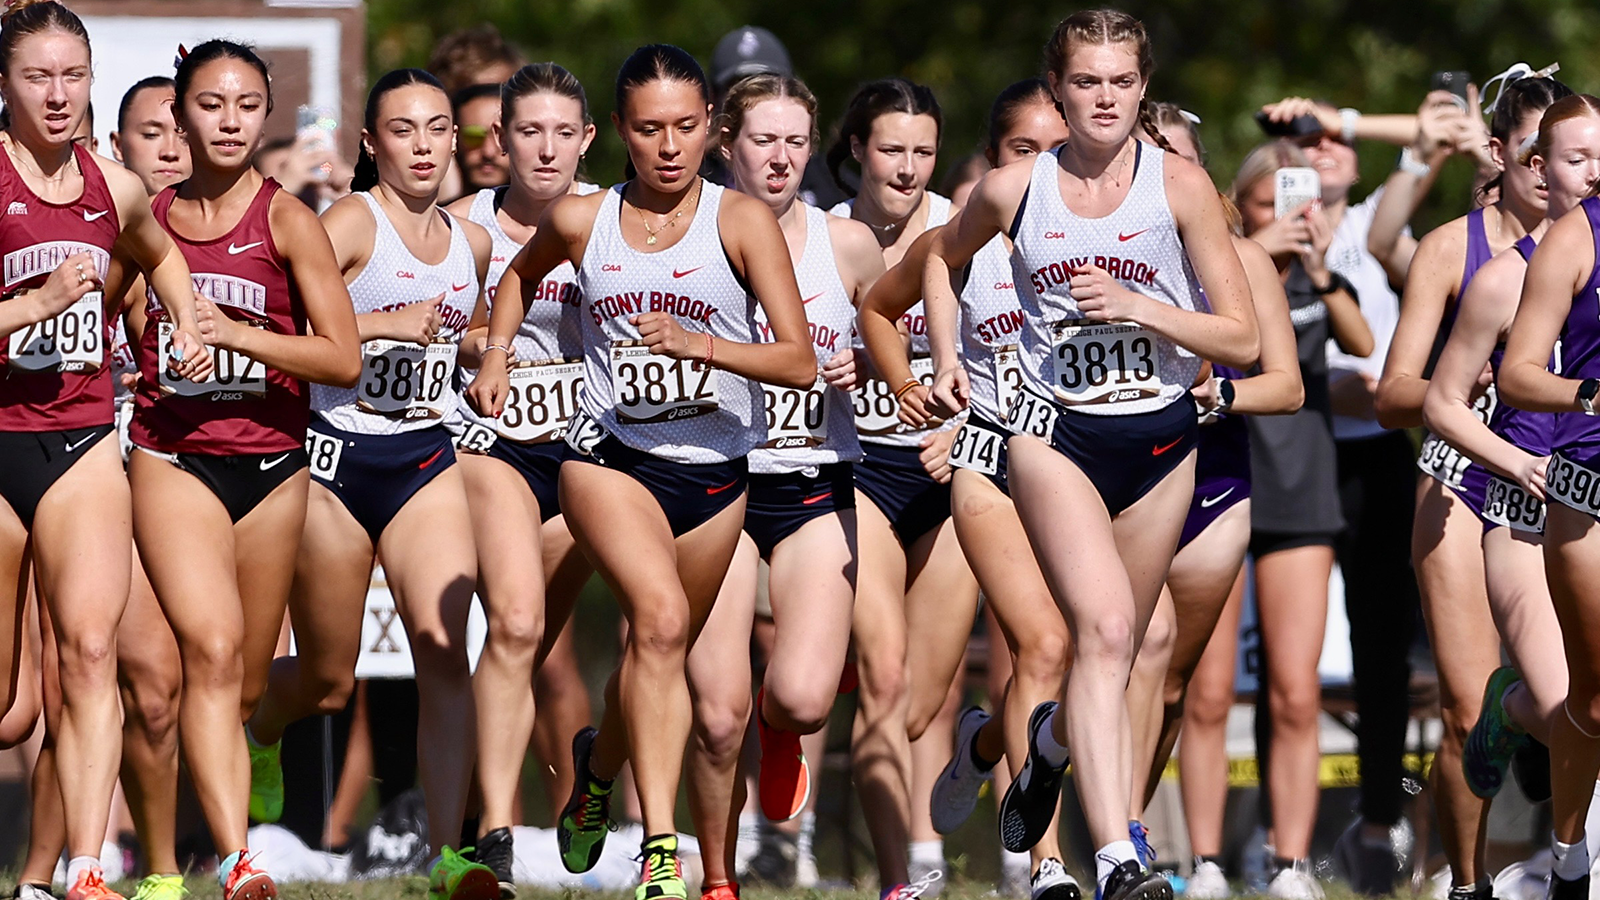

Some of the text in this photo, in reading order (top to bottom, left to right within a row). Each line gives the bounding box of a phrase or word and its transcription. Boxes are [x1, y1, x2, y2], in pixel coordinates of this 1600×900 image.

[1044, 231, 1065, 239] CAA
[396, 270, 415, 279] CAA
[602, 264, 621, 272] CAA
[994, 282, 1014, 290] CAA
[1030, 255, 1159, 295] STONY BROOK
[589, 291, 719, 327] STONY BROOK
[16, 310, 97, 356] 2993
[1066, 328, 1092, 337] LEHIGH
[1094, 327, 1113, 335] PAUL
[1115, 325, 1137, 333] SHORT
[365, 355, 447, 402] 3818
[536, 369, 554, 377] PAUL
[555, 366, 577, 374] SHORT
[1058, 337, 1154, 389] 3813
[618, 359, 714, 407] 3812
[1008, 391, 1052, 437] 813
[950, 426, 996, 468] 814
